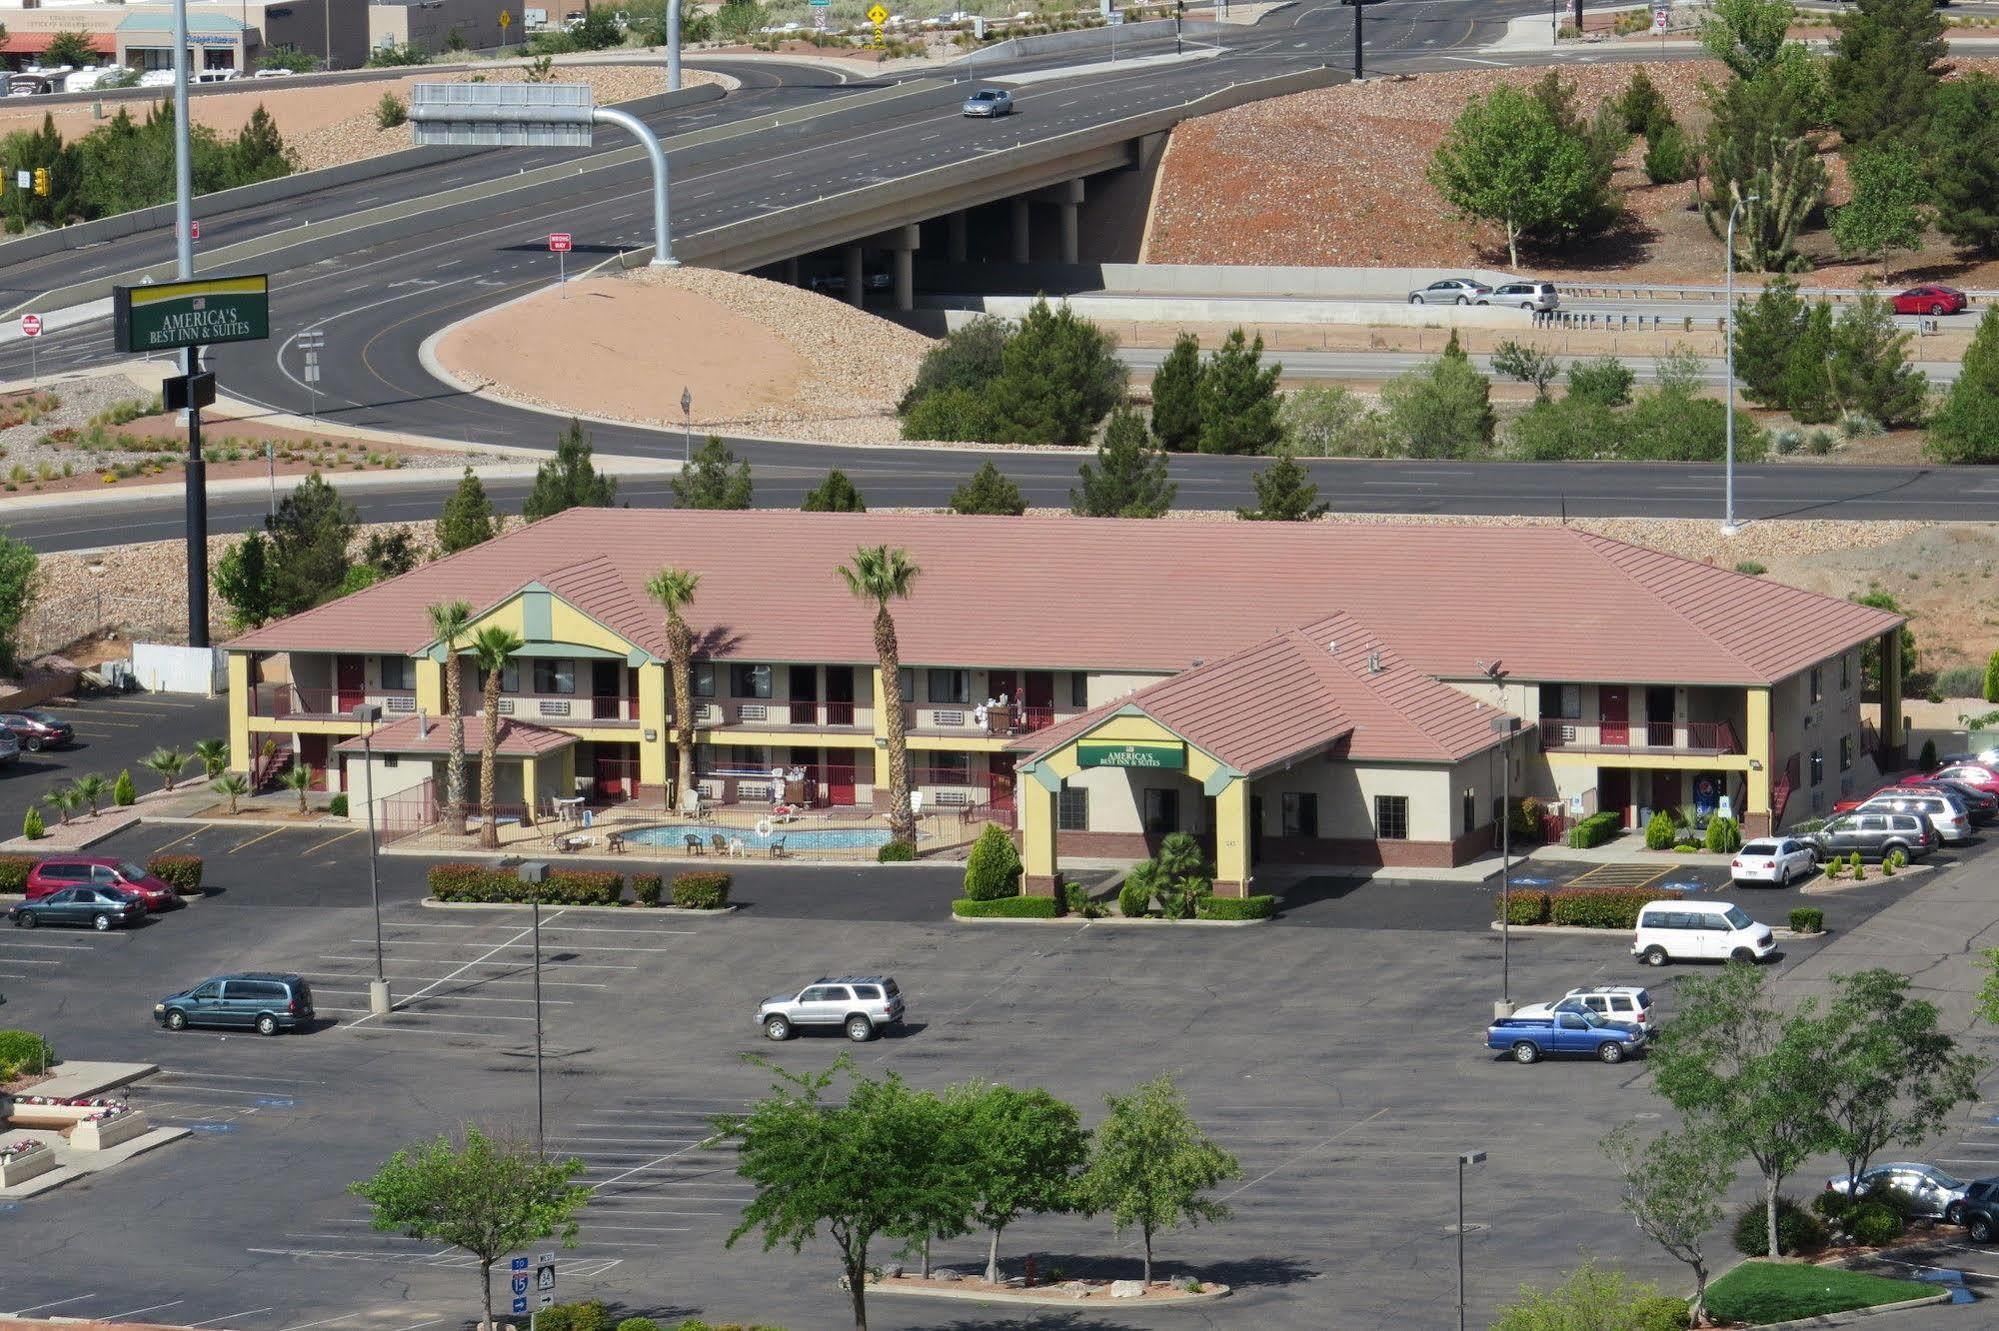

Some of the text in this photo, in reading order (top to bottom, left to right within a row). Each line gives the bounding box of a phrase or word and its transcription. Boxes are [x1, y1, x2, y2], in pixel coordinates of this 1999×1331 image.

[162, 307, 238, 331] AMERICA'S
[150, 321, 250, 344] BEST INN & SUITES
[1107, 752, 1153, 761] AMERICA'S
[1138, 759, 1160, 767] SUITES
[516, 1260, 525, 1268] TO
[515, 1278, 526, 1292] 15
